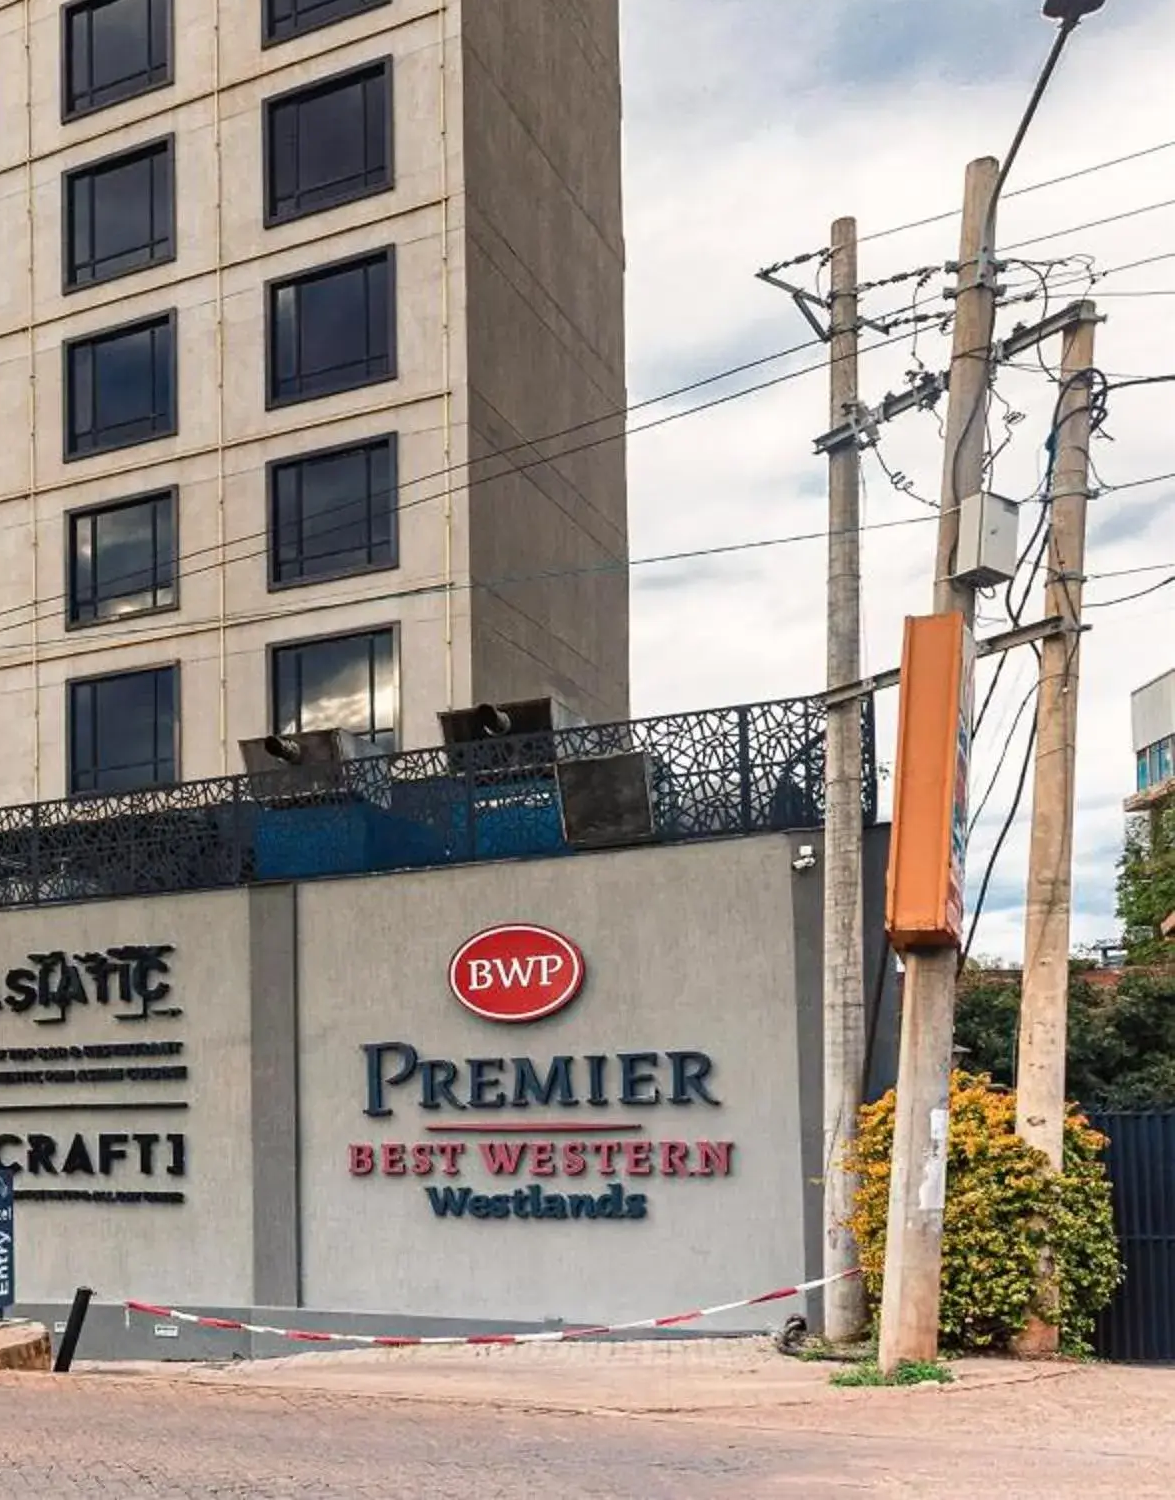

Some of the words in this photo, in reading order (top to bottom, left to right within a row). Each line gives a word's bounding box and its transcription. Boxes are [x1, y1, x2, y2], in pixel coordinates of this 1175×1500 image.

[466, 954, 564, 991] BWP
[360, 1042, 722, 1117] PREMIER
[348, 1141, 466, 1176] BEST
[478, 1140, 735, 1177] WESTERN
[425, 1182, 648, 1220] Westlands
